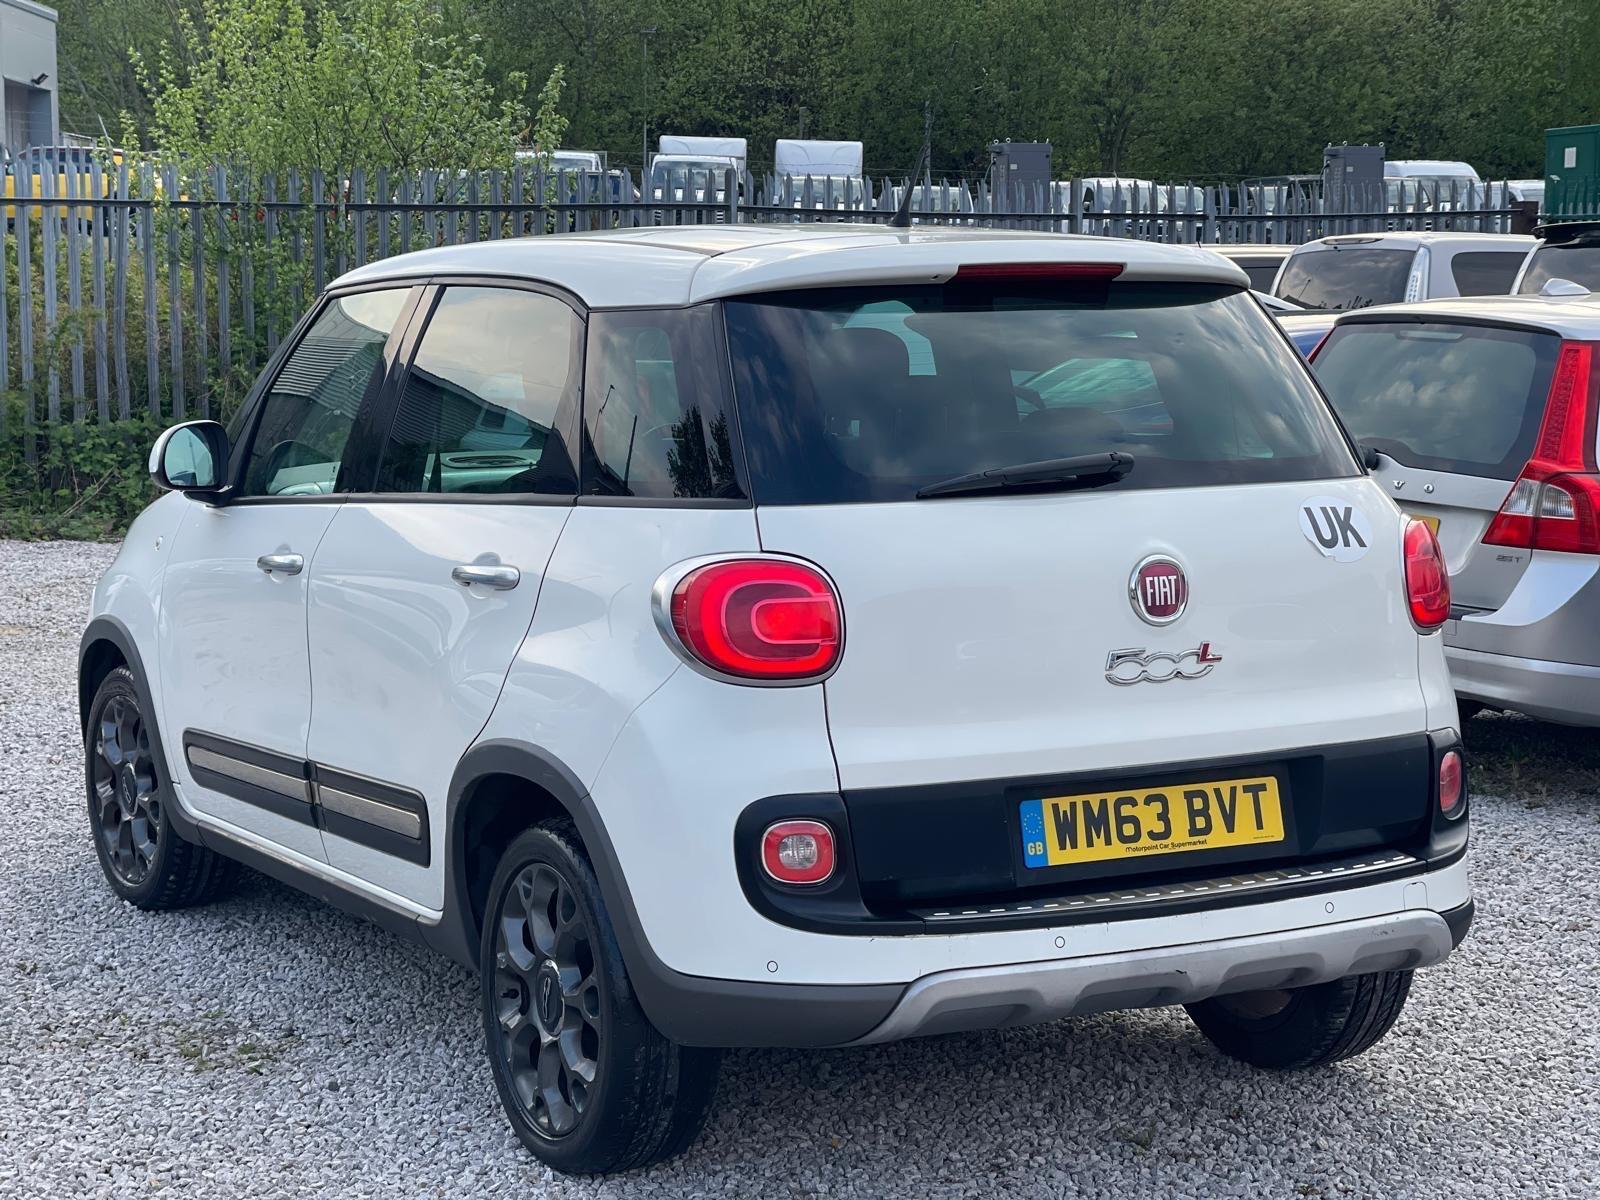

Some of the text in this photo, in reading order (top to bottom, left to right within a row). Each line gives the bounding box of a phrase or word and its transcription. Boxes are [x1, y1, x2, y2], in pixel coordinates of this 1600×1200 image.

[1304, 506, 1368, 549] UK
[1145, 575, 1177, 606] FIAT
[1051, 783, 1268, 851] WM63 BVT
[1027, 842, 1044, 855] GB
[1125, 839, 1208, 853] Motorpoint Car Supermarket
